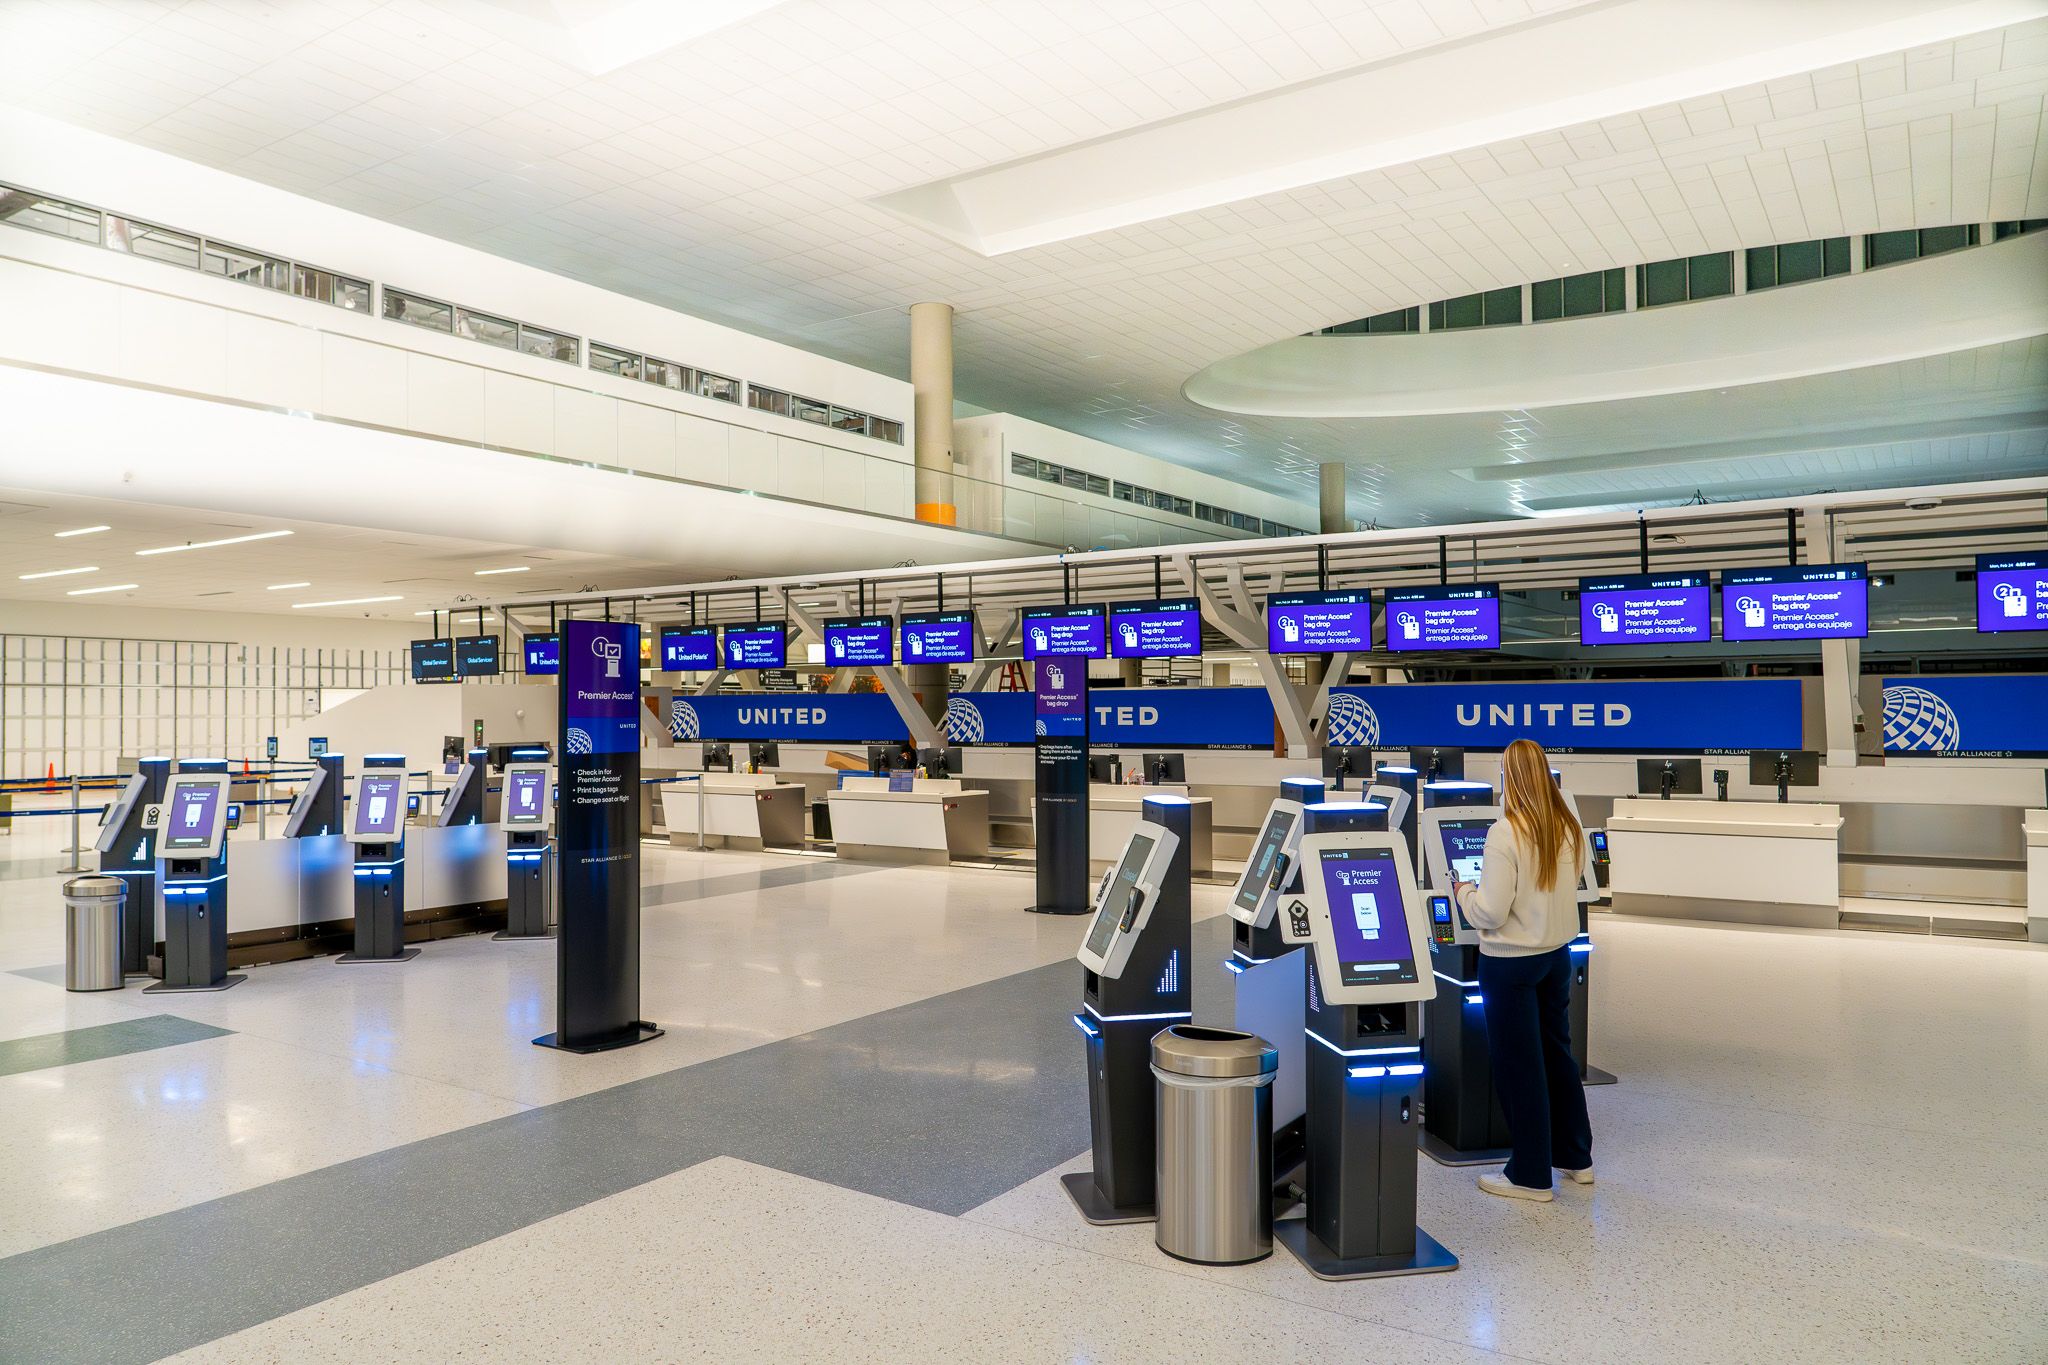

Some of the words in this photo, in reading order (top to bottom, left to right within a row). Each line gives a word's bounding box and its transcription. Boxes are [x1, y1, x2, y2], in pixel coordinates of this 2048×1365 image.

[1772, 603, 1789, 611] bag
[1790, 602, 1810, 610] drop
[1625, 609, 1640, 617] bag
[578, 691, 611, 700] Premier
[737, 708, 827, 725] UNITED
[1094, 706, 1159, 726] TED
[1456, 703, 1632, 727] UNITED
[1780, 752, 1788, 761] hp
[1665, 760, 1672, 768] hp
